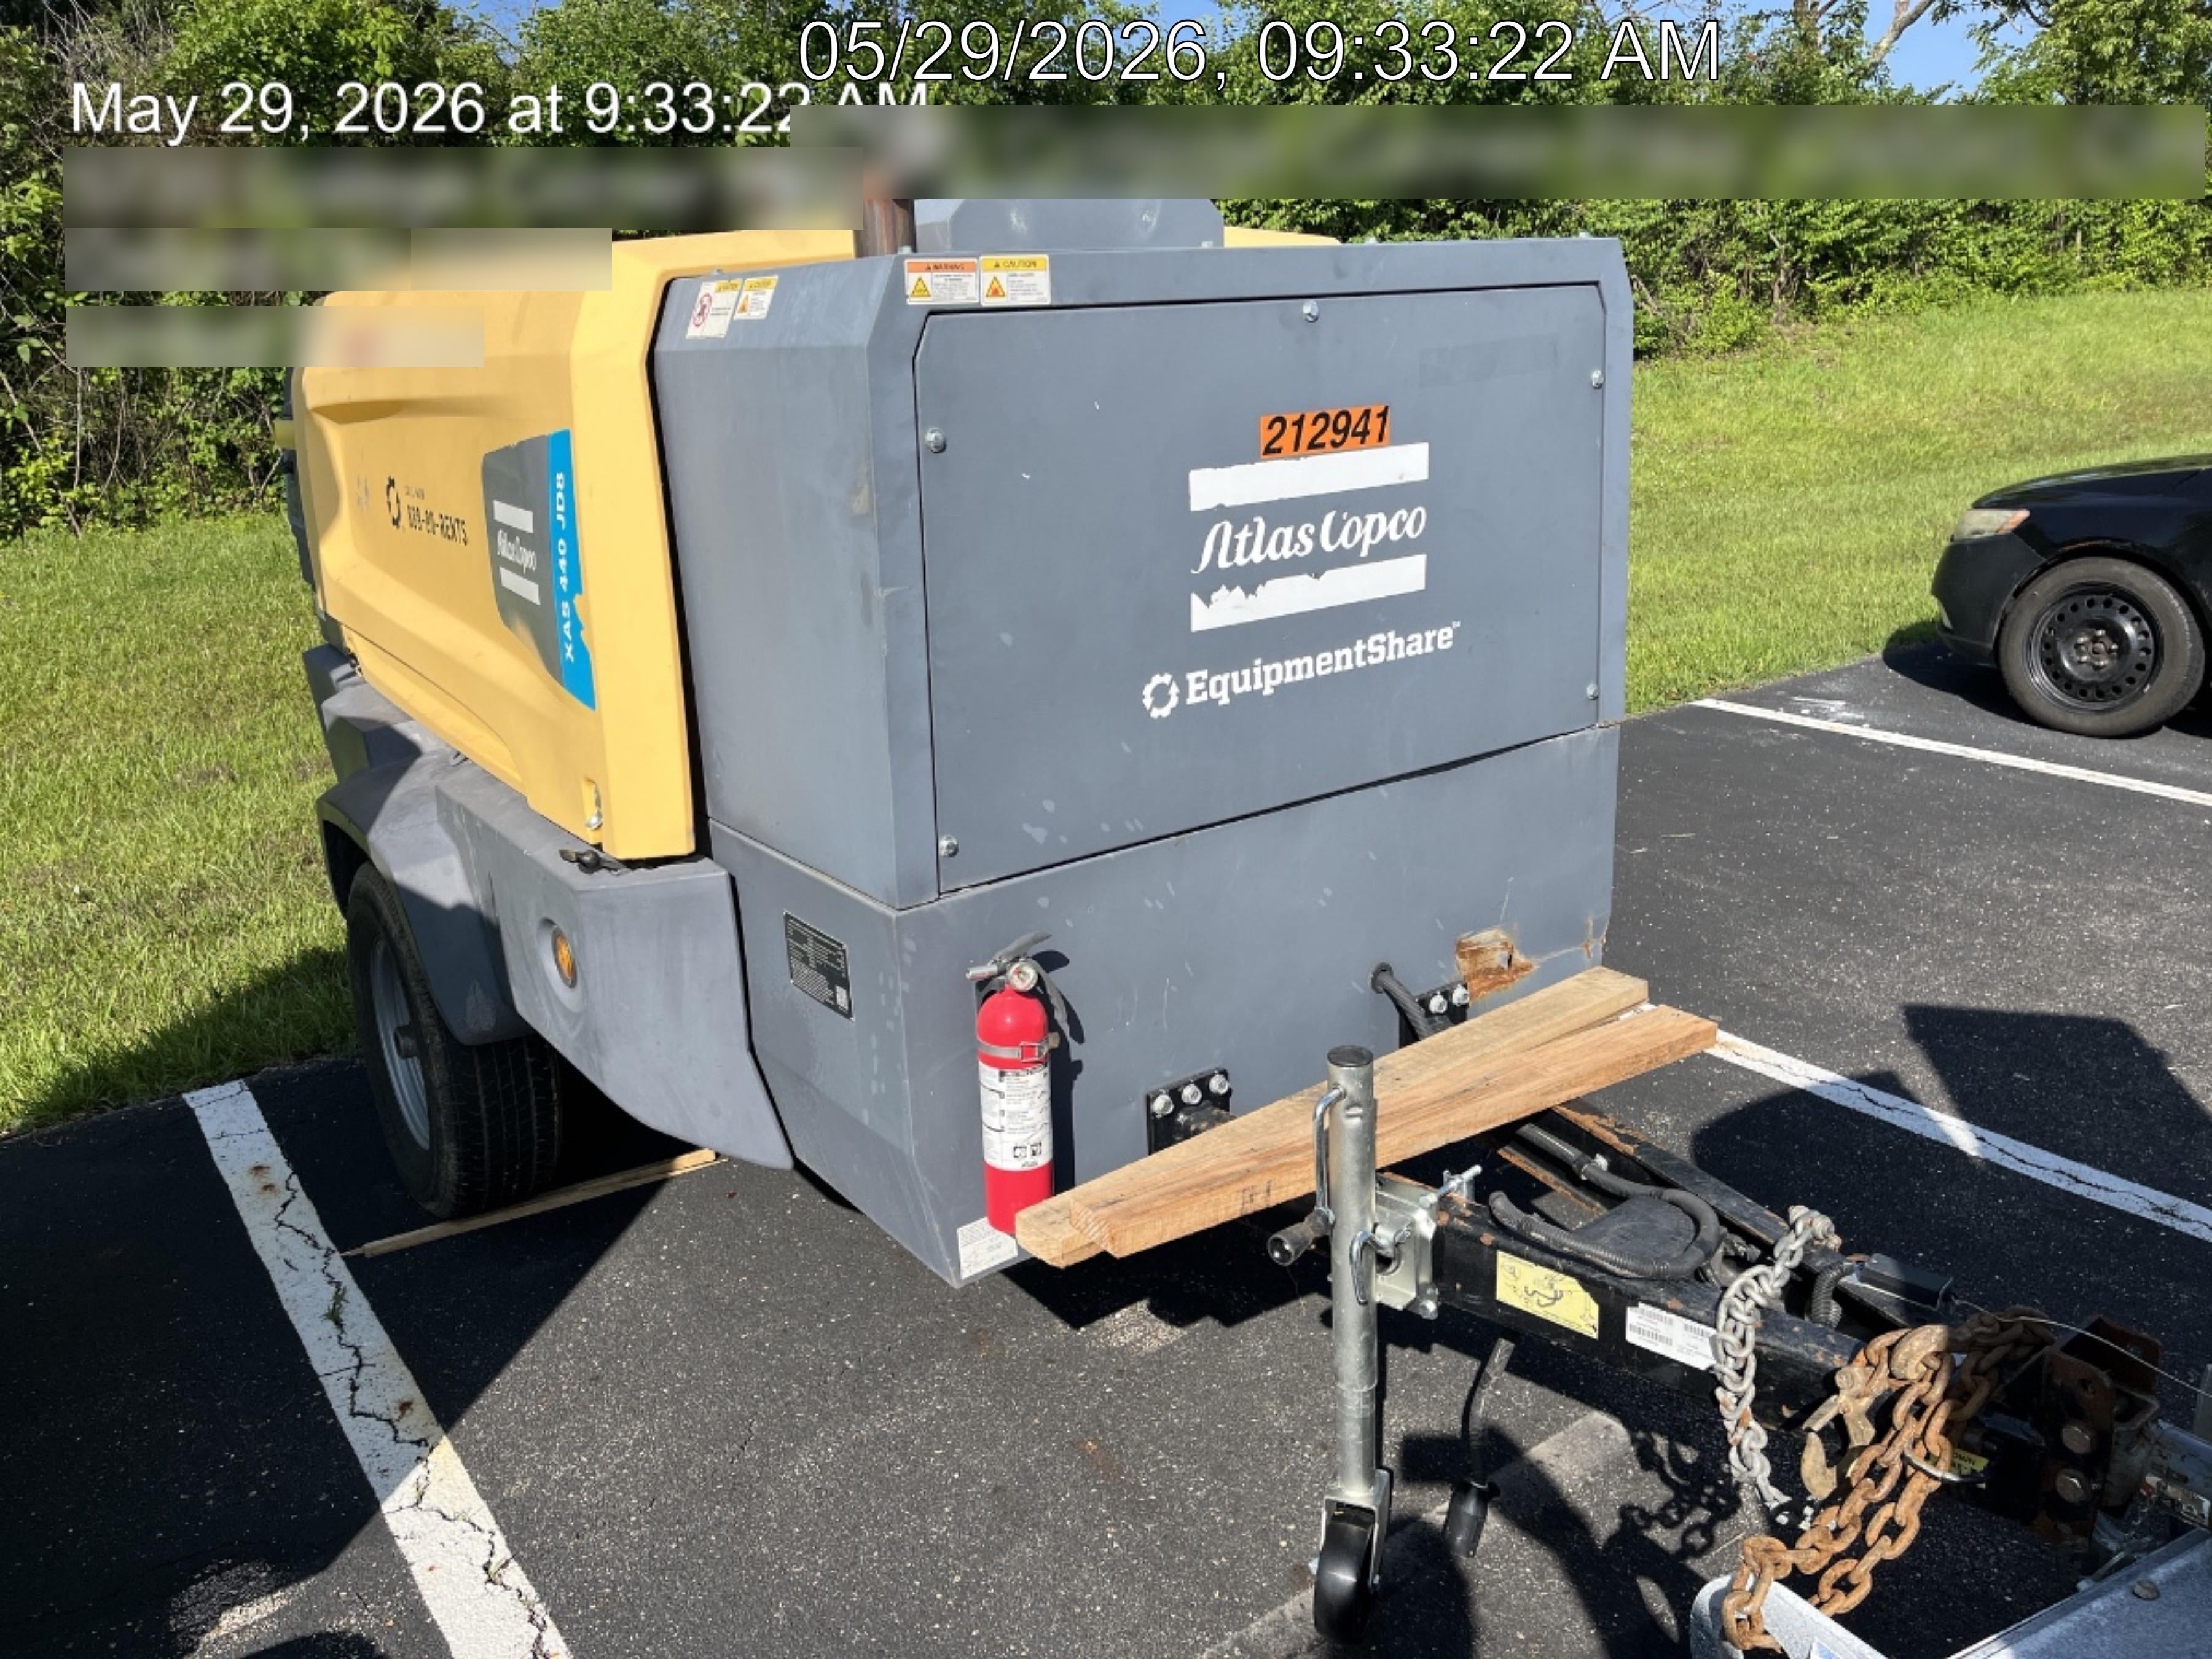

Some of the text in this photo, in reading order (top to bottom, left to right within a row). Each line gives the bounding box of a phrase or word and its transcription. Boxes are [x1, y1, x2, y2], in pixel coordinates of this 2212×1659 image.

[1263, 405, 1390, 455] 212941
[558, 538, 569, 592] 440
[561, 600, 575, 662] XAS
